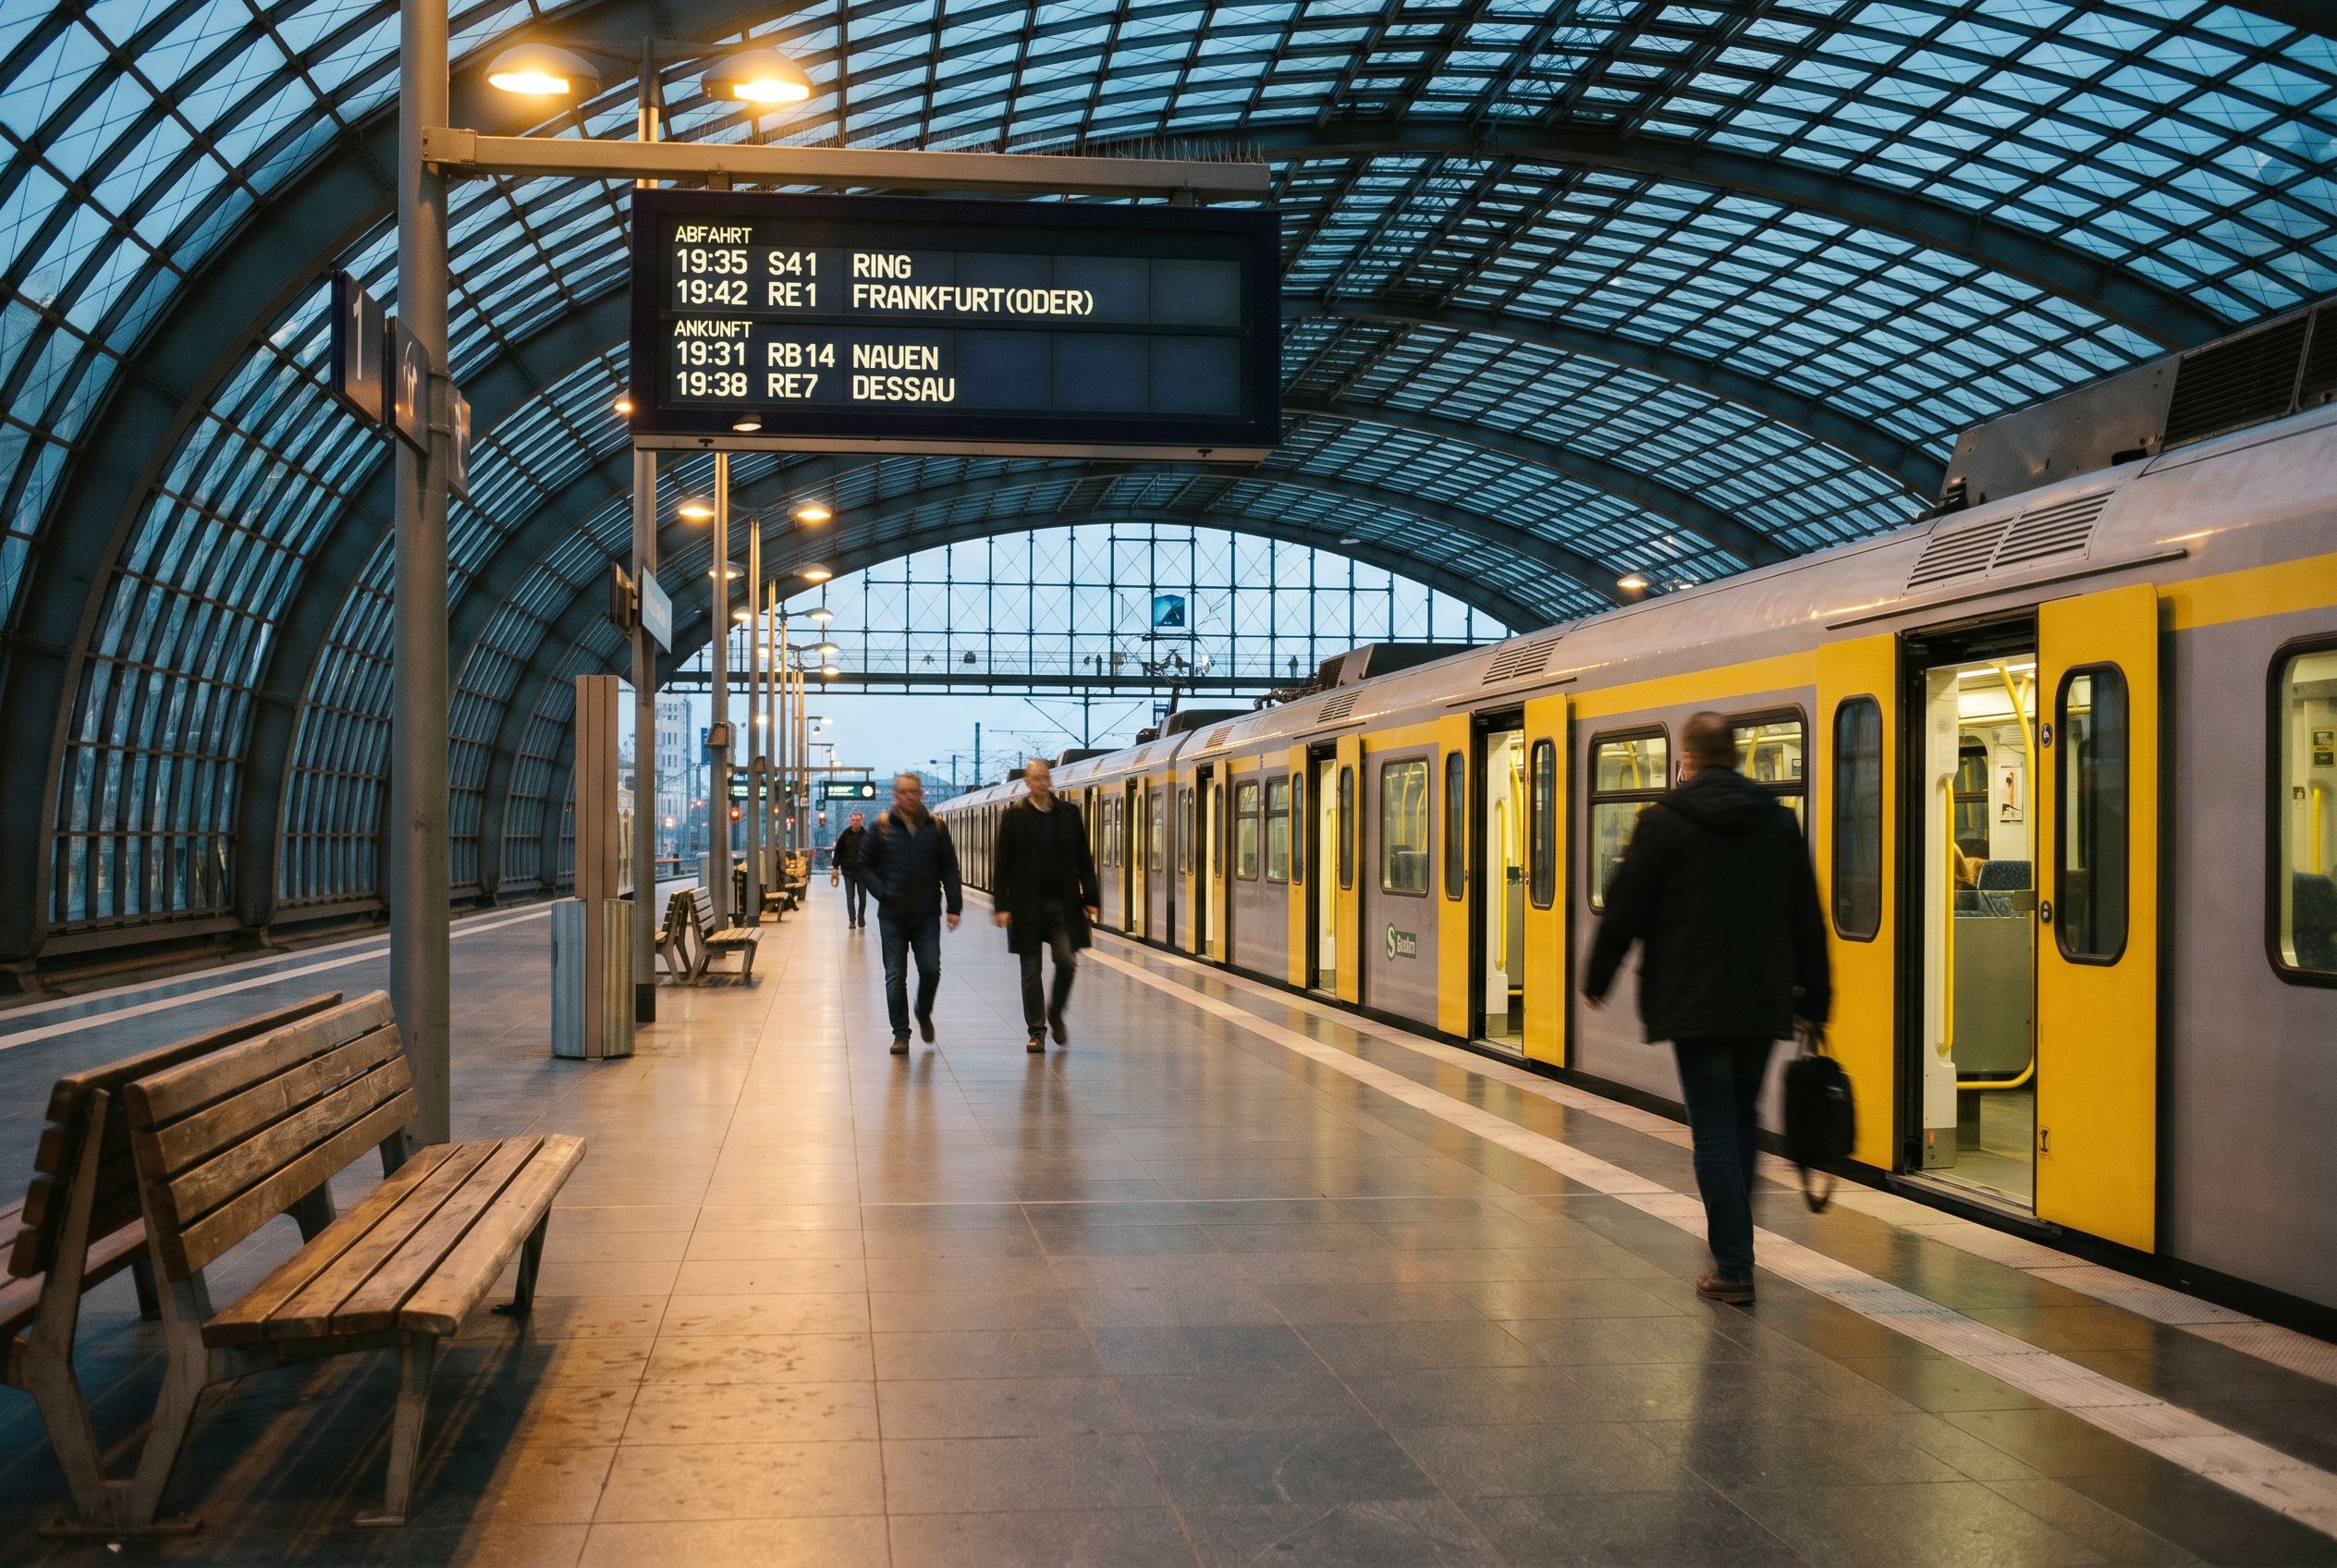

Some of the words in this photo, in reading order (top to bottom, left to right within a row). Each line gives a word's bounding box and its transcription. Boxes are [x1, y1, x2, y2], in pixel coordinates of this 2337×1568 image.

[675, 226, 752, 244] ABFAHRT
[677, 248, 748, 275] 19:35
[768, 251, 816, 276] S41
[853, 252, 912, 279] RING
[677, 278, 748, 305] 19:42
[768, 281, 816, 307] RE1
[853, 283, 1094, 316] FRANKFURT(ODER)
[352, 288, 363, 382] 1
[673, 319, 753, 338] ANKUNFT
[677, 340, 747, 366] 19:31
[767, 342, 836, 369] RB14
[852, 344, 939, 371] NAUEN
[677, 371, 748, 398] 19:38
[767, 373, 819, 398] RE7
[852, 374, 955, 403] DESSAU
[1387, 925, 1396, 958] S
